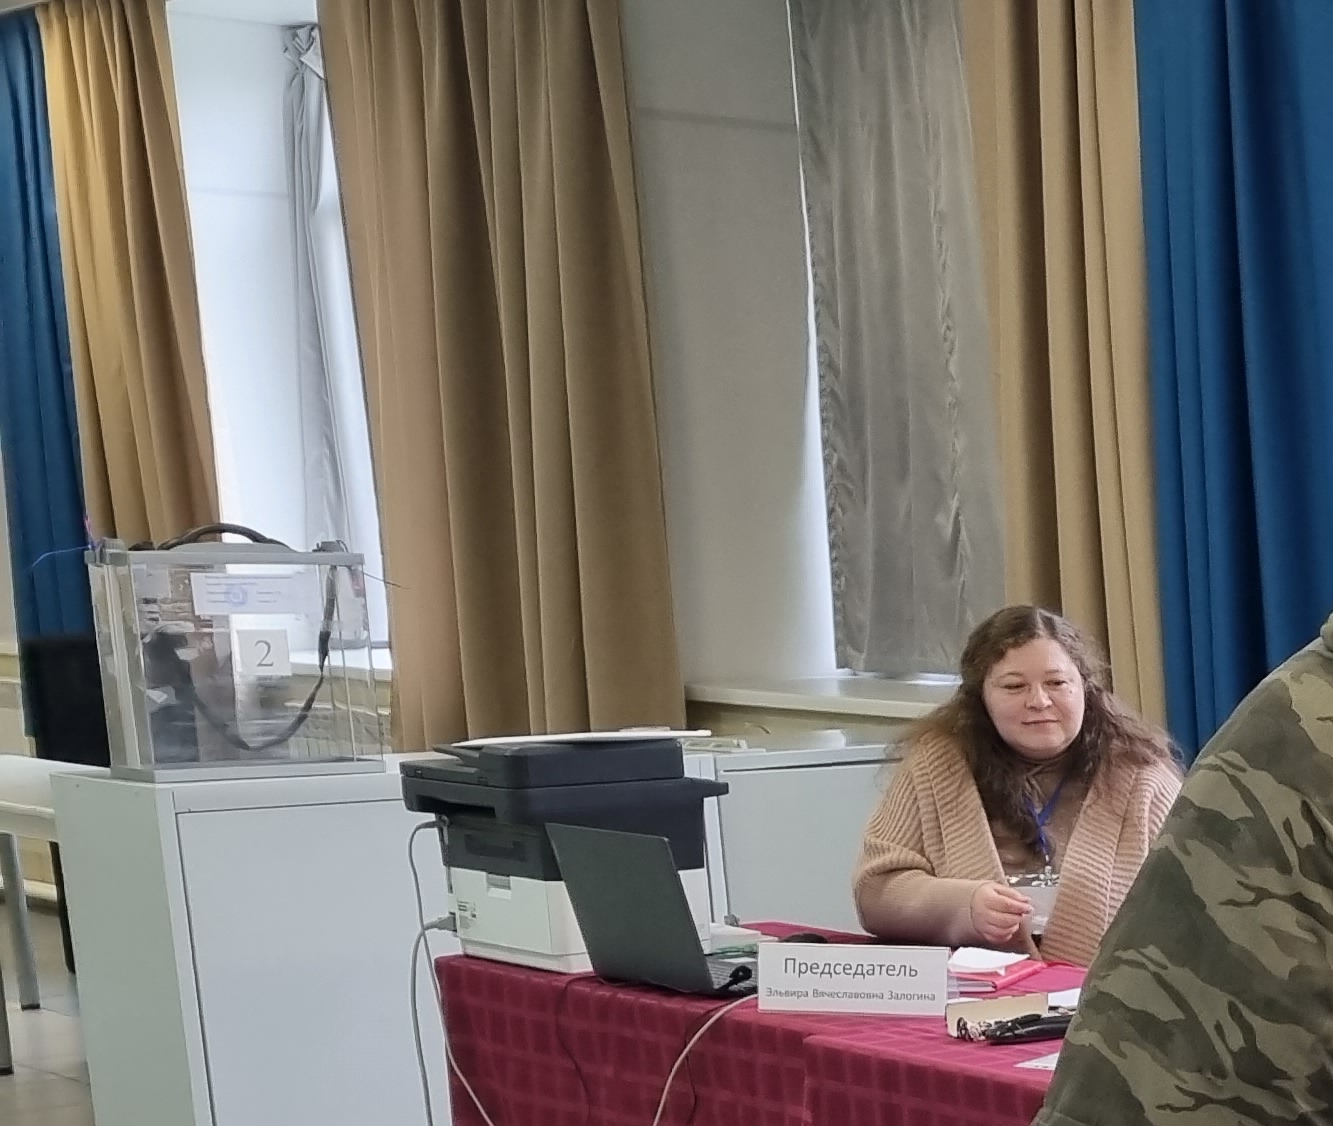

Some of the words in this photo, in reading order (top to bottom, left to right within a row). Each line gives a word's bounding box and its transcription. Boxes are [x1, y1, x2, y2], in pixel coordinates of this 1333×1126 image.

[254, 639, 274, 667] 2
[784, 957, 918, 979] Председатель
[766, 987, 809, 999] Эльвира
[812, 988, 884, 1000] Вячеславовна
[888, 990, 936, 1002] Залогина
